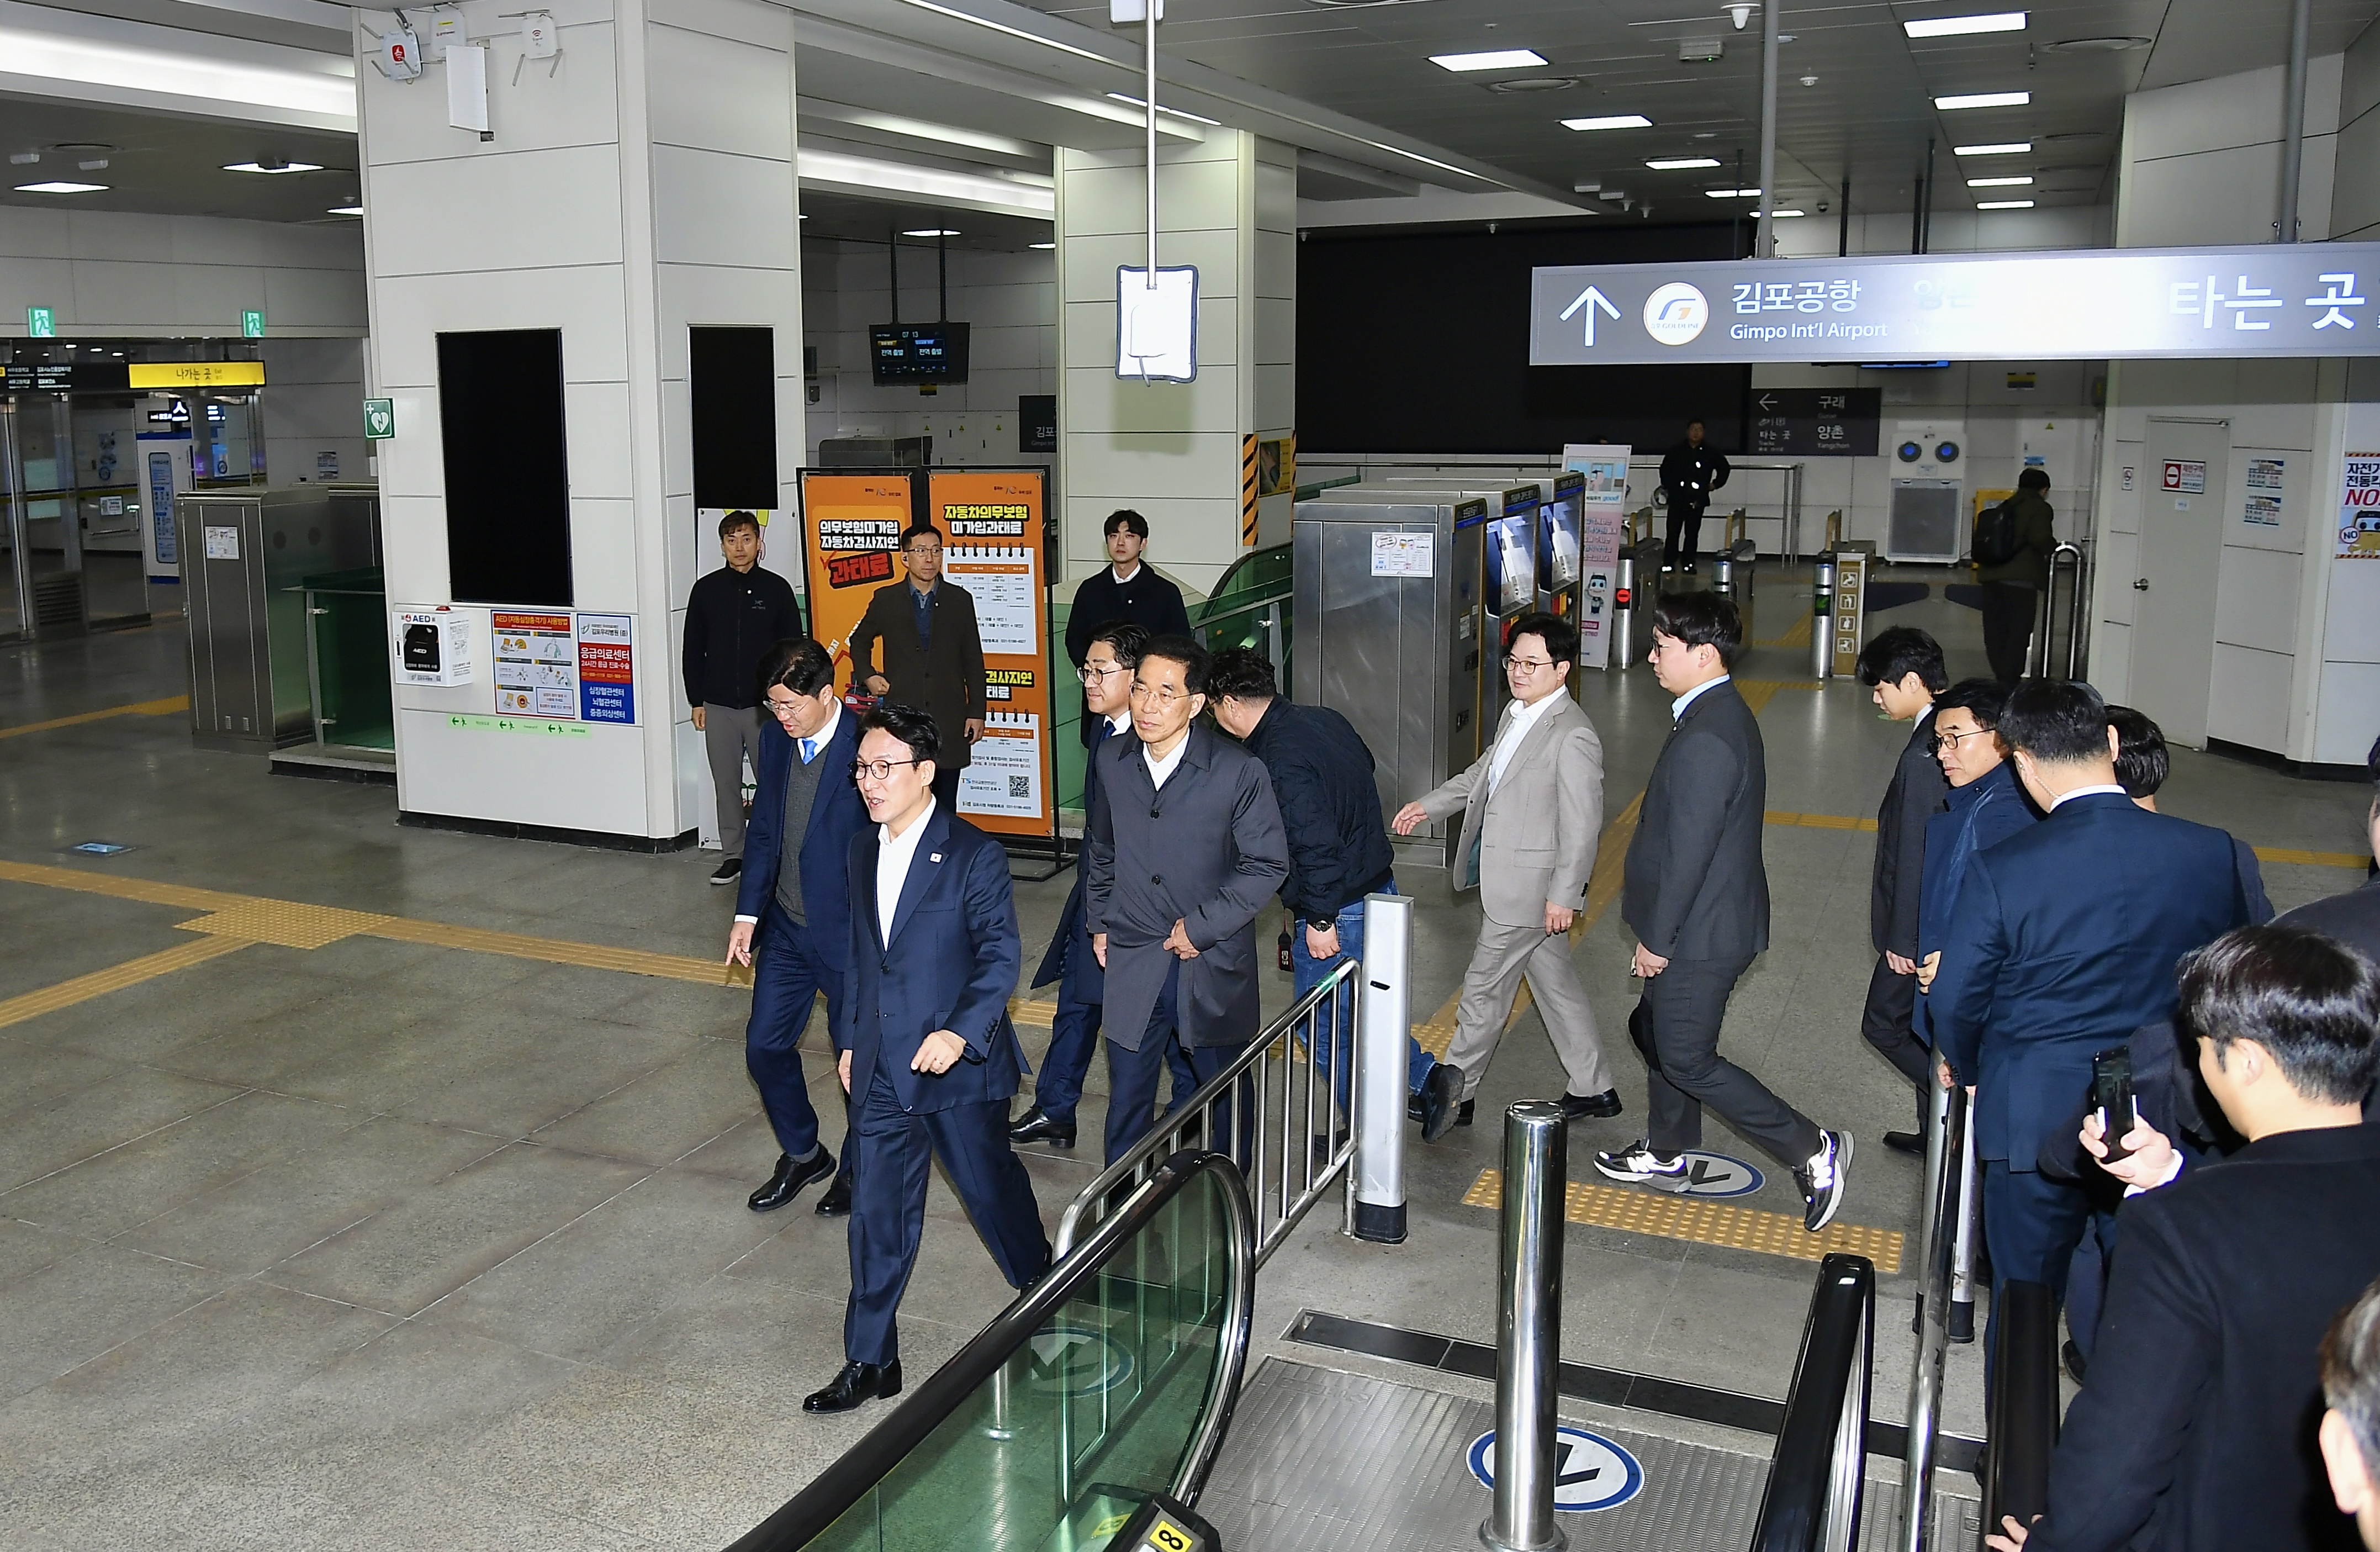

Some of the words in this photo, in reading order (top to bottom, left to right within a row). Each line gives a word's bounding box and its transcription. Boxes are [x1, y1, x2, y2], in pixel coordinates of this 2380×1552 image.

[1732, 279, 1861, 315] 김포공항
[2169, 274, 2283, 330] 타는
[2305, 273, 2366, 330] 곳
[1730, 323, 1787, 342] Gimpo
[1791, 322, 1823, 339] Int'l
[1827, 322, 1887, 342] Airport
[176, 368, 200, 380] 나가는
[204, 368, 211, 380] 곳
[1818, 395, 1845, 409] 구래
[1036, 426, 1056, 437] 김포
[1759, 430, 1776, 440] 타는
[1817, 425, 1844, 440] 양촌
[944, 505, 1027, 519] 자동차의무보험
[820, 521, 898, 534] 의무보험미가입
[951, 521, 1022, 534] 미가입과태료
[2344, 531, 2358, 540] NO
[821, 536, 899, 549] 자동차검사지연
[831, 552, 890, 584] 과태료
[580, 647, 630, 661] 응급의료센터
[985, 671, 1032, 684] 검사지연
[589, 687, 625, 697] 심장혈관센터
[986, 685, 1009, 698] 태료
[592, 698, 622, 708] 뇌혈관센터
[1159, 1529, 1183, 1550] 8
